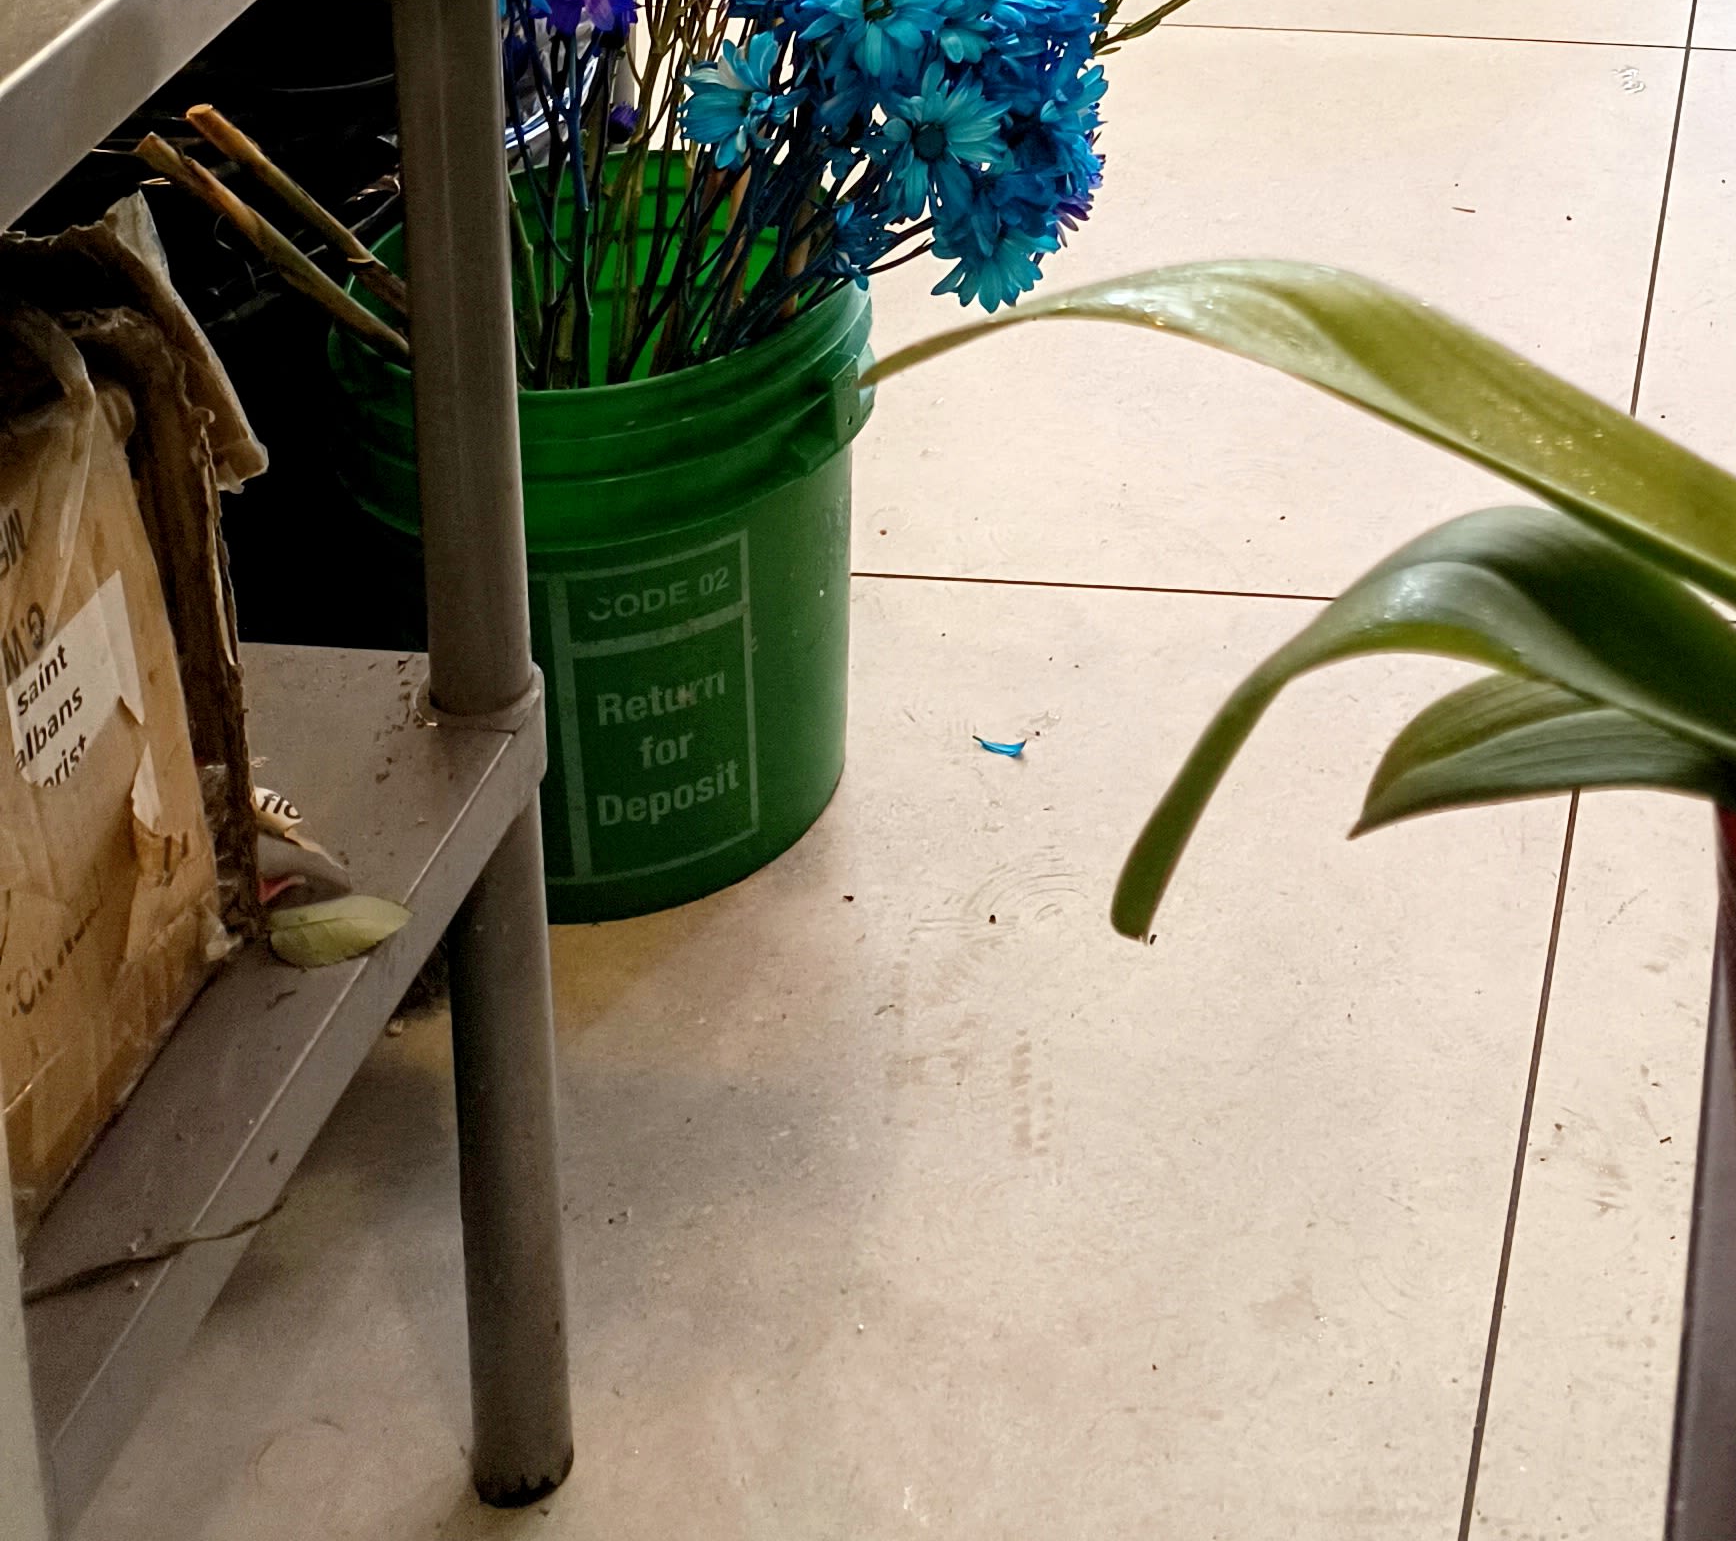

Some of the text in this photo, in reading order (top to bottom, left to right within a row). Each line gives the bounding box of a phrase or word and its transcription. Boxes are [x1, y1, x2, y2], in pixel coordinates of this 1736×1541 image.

[588, 567, 730, 621] CODE 02
[17, 644, 69, 717] saint
[597, 671, 727, 727] Return
[15, 686, 84, 770] albans
[639, 731, 695, 769] for
[597, 759, 741, 827] Deposit
